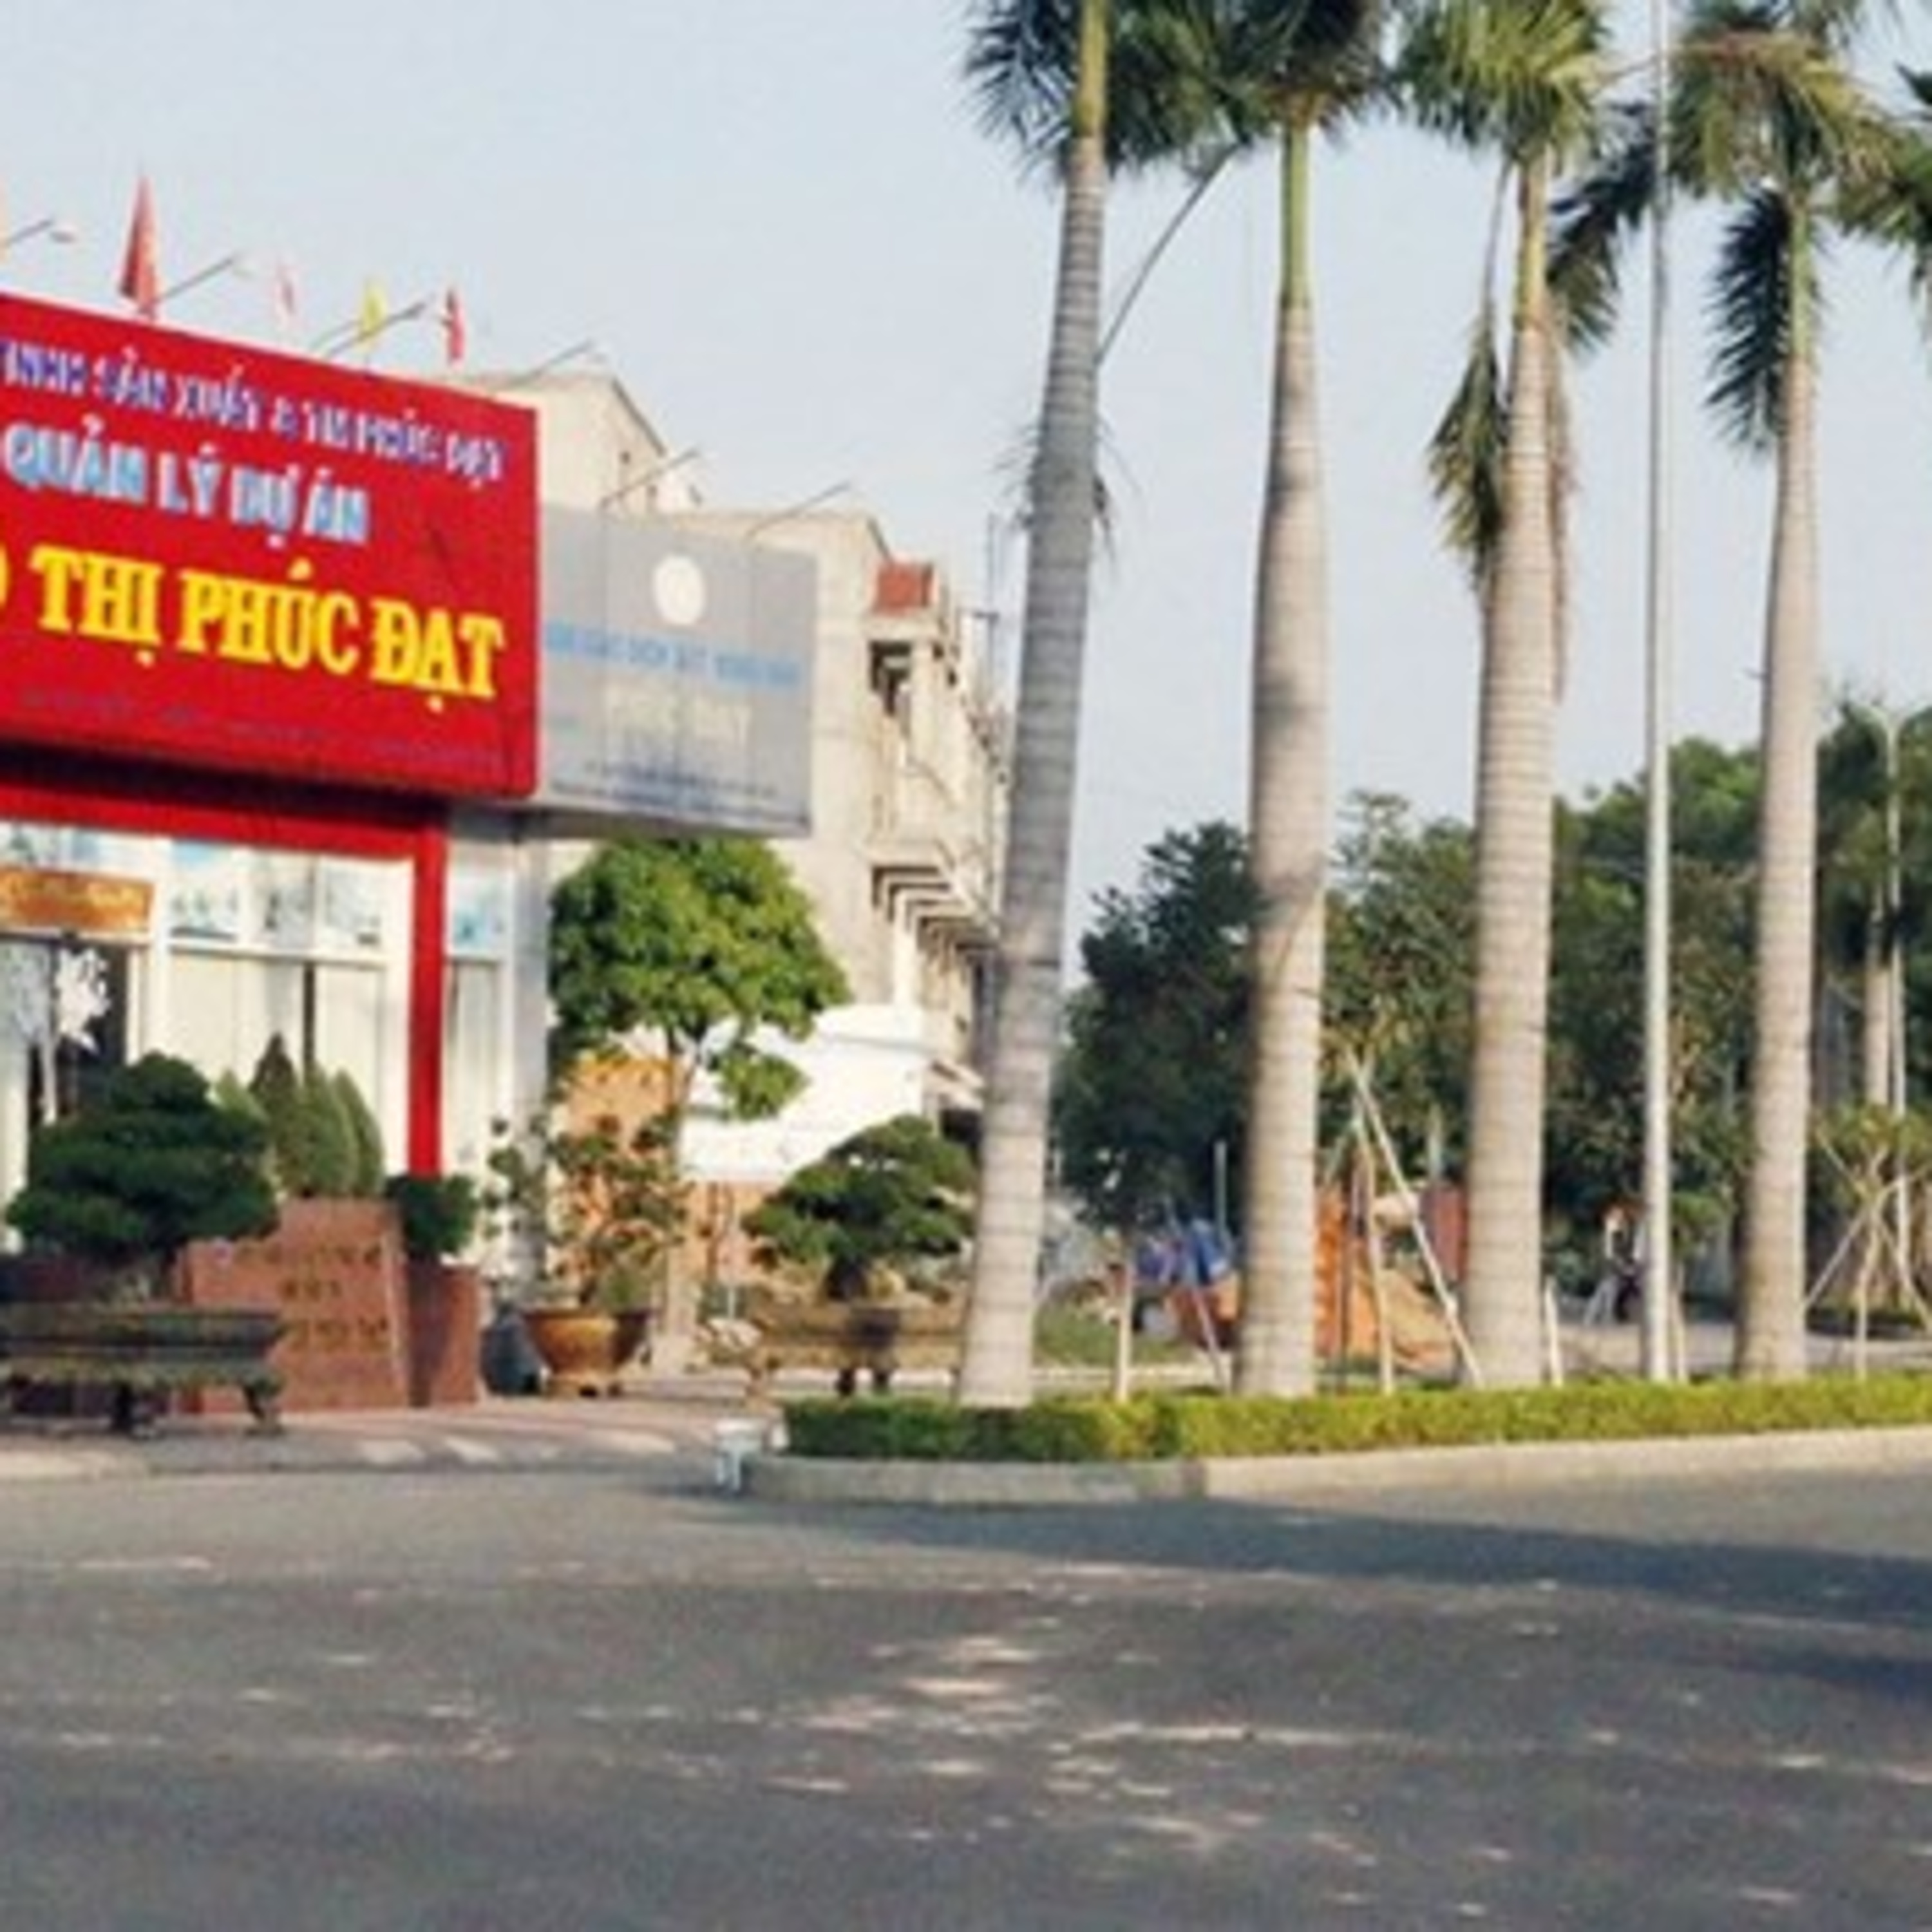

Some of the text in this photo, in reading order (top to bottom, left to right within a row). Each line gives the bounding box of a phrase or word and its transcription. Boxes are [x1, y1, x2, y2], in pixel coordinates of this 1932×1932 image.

[4, 413, 369, 548] QUẢN LÝ DỰ ÁN
[28, 544, 164, 667] THỊ
[177, 557, 361, 675] PHÚC
[370, 599, 506, 714] ĐẠT
